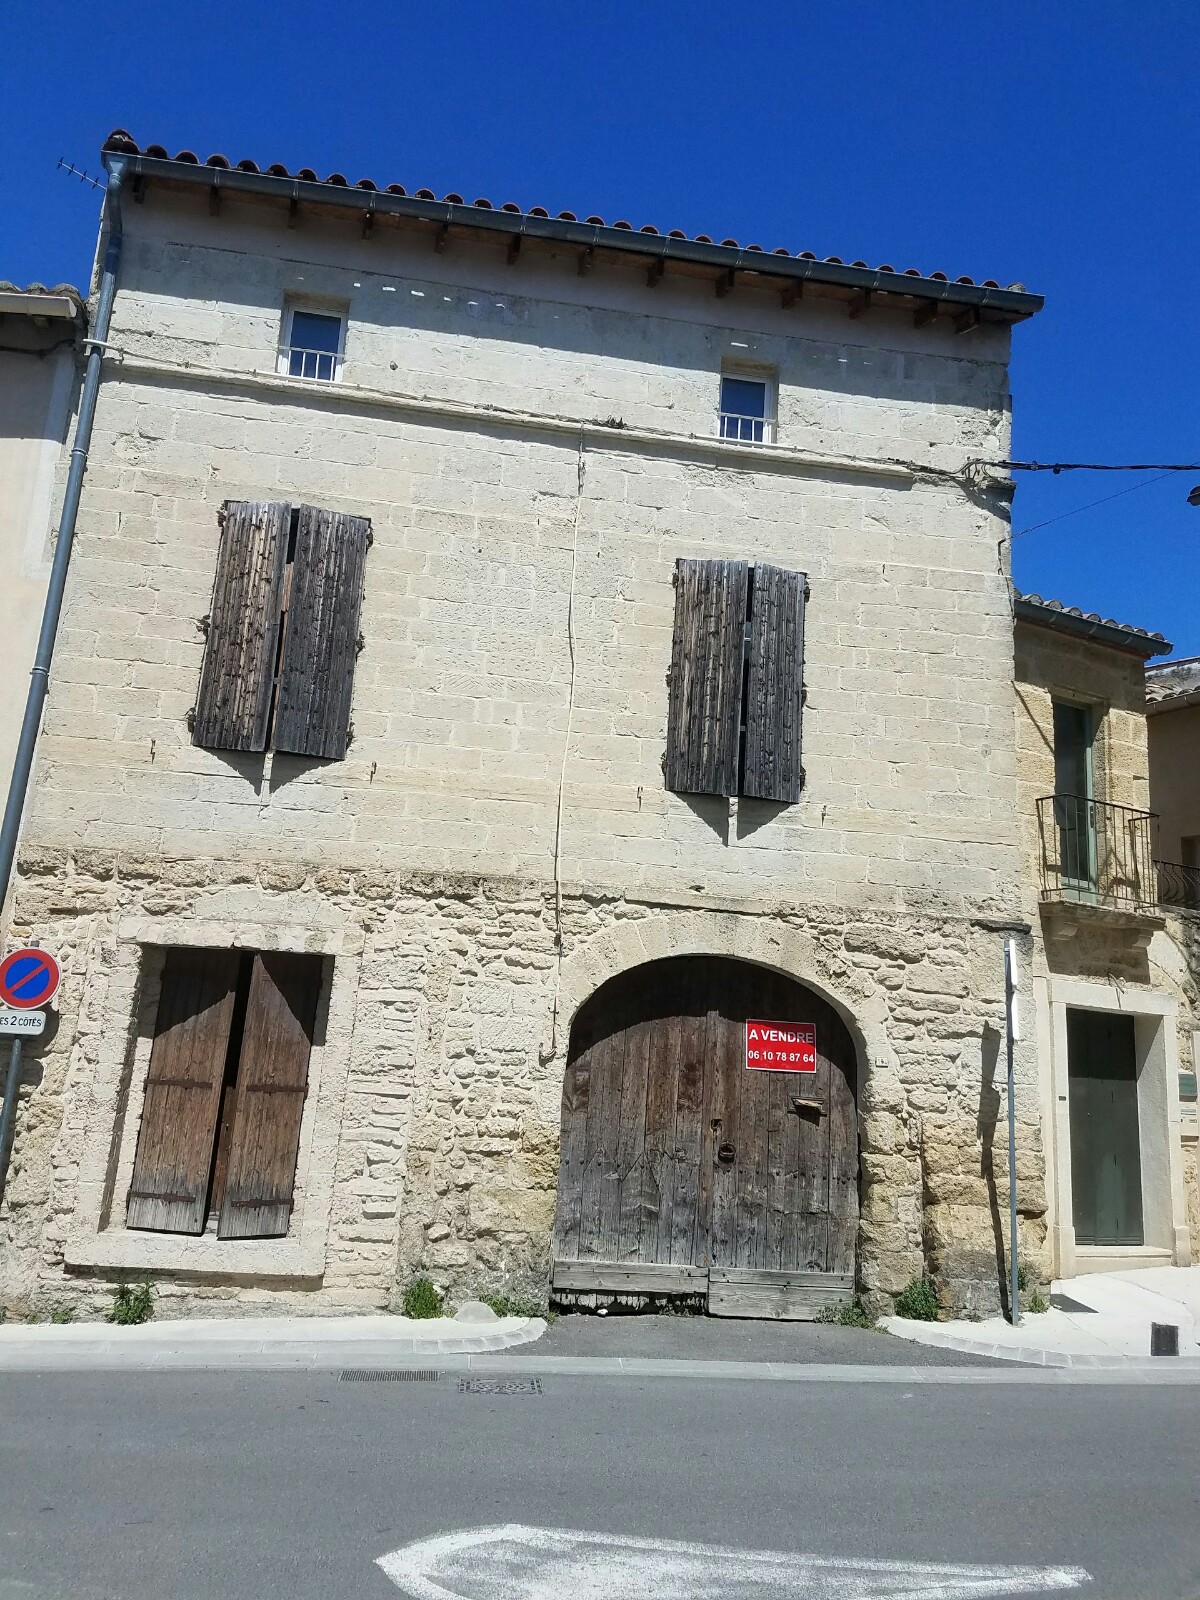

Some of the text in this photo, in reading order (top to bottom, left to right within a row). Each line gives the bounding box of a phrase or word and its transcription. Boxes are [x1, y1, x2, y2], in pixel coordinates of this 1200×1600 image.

[10, 1016, 17, 1025] 2
[18, 1016, 42, 1027] CÔTÉS
[749, 1029, 814, 1043] A VENDRE
[748, 1050, 814, 1062] 06 10 78 87 64
